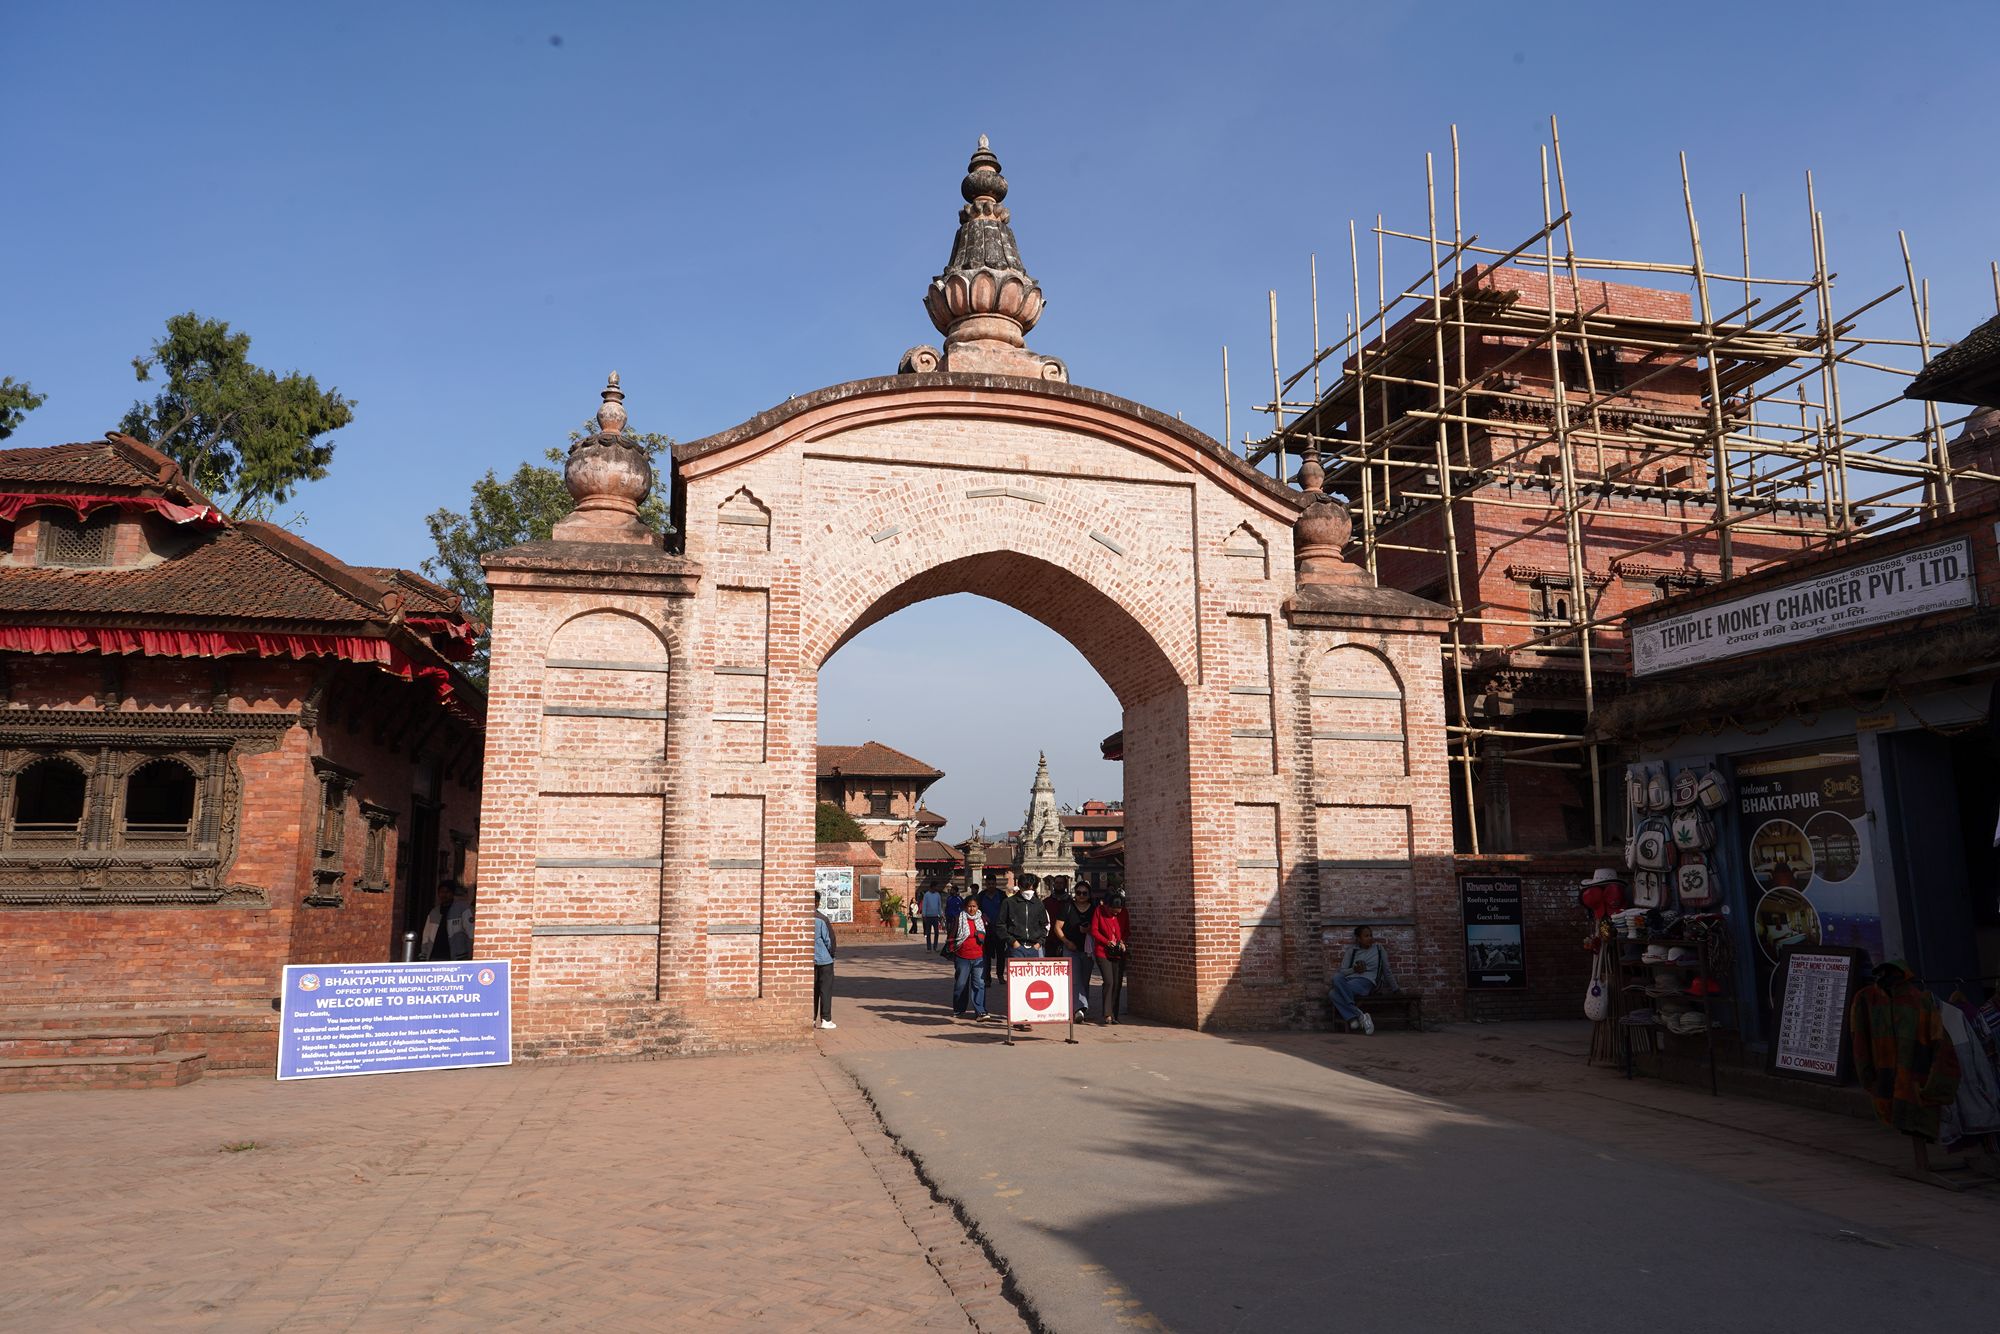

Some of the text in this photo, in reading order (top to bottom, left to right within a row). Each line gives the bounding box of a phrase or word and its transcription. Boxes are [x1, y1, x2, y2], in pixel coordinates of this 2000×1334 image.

[1816, 543, 1962, 588] Contact: 9851026698, 9843169930
[1660, 555, 1966, 649] TEMPLE MONEY CHANGER PVT. LTD.
[1816, 598, 1967, 633] Email: templemoneychanger@gmail.com
[1726, 632, 1759, 645] टेम्पल
[1736, 767, 1748, 776] One
[1750, 765, 1756, 774] of
[1740, 782, 1782, 795] Welcome To
[1743, 792, 1820, 813] BHAKTAPUR
[1010, 962, 1033, 977] सवारी
[1035, 962, 1052, 976] प्रवेश
[325, 974, 473, 987] BHAKTAPUR MUNICIPALITY
[316, 993, 480, 1009] WELCOME TO BHAKTAPUR
[1781, 1056, 1835, 1072] NO COMMISSION
